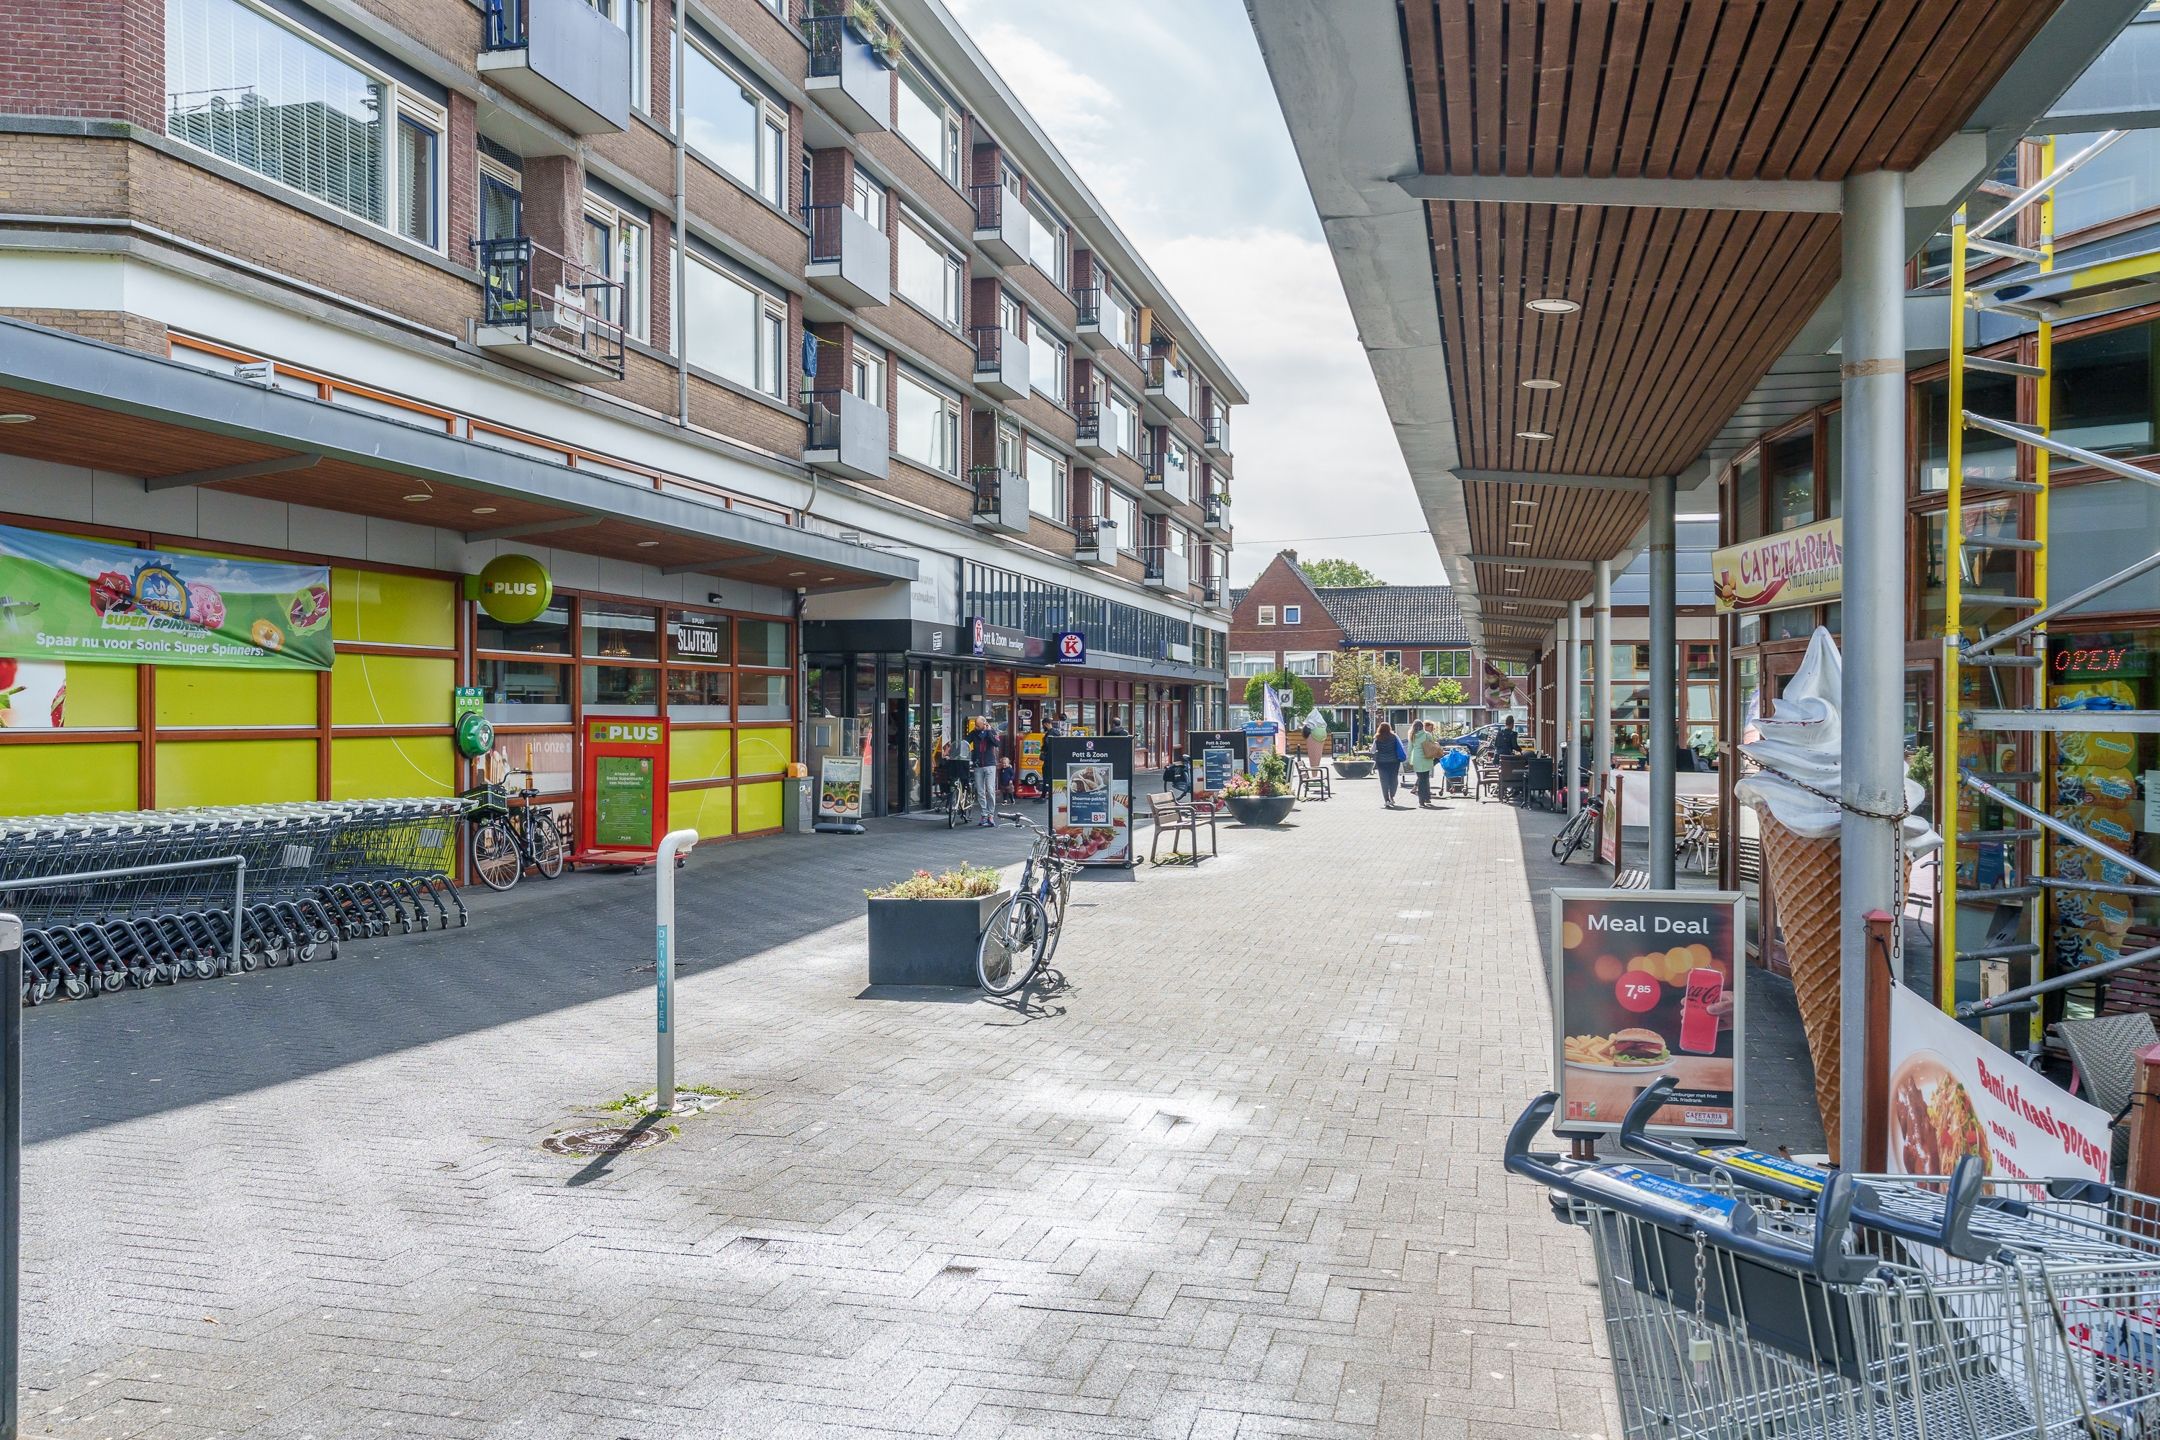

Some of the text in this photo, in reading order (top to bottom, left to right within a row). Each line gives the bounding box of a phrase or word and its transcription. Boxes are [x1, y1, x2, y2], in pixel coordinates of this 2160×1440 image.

[1740, 528, 1839, 587] CAFETARIA
[494, 582, 537, 596] PLUS
[106, 614, 148, 627] SUPER
[36, 632, 79, 648] Spaar
[82, 638, 99, 648] nu
[102, 640, 133, 650] voor
[136, 639, 171, 652] Sonic
[174, 641, 209, 655] Super
[678, 628, 718, 653] SLIJTERIJ
[1064, 640, 1079, 654] K
[2055, 648, 2127, 672] OPEN
[465, 689, 475, 697] AED
[609, 726, 659, 741] PLUS
[533, 737, 542, 753] in
[544, 742, 565, 753] onze
[1587, 914, 1710, 935] Meal Deal
[658, 929, 666, 1029] DRINKWATER
[1624, 983, 1651, 1000] 7,85
[1685, 1111, 1723, 1120] CAFETARIA
[1976, 1056, 2109, 1184] Bami of nasi goreng
